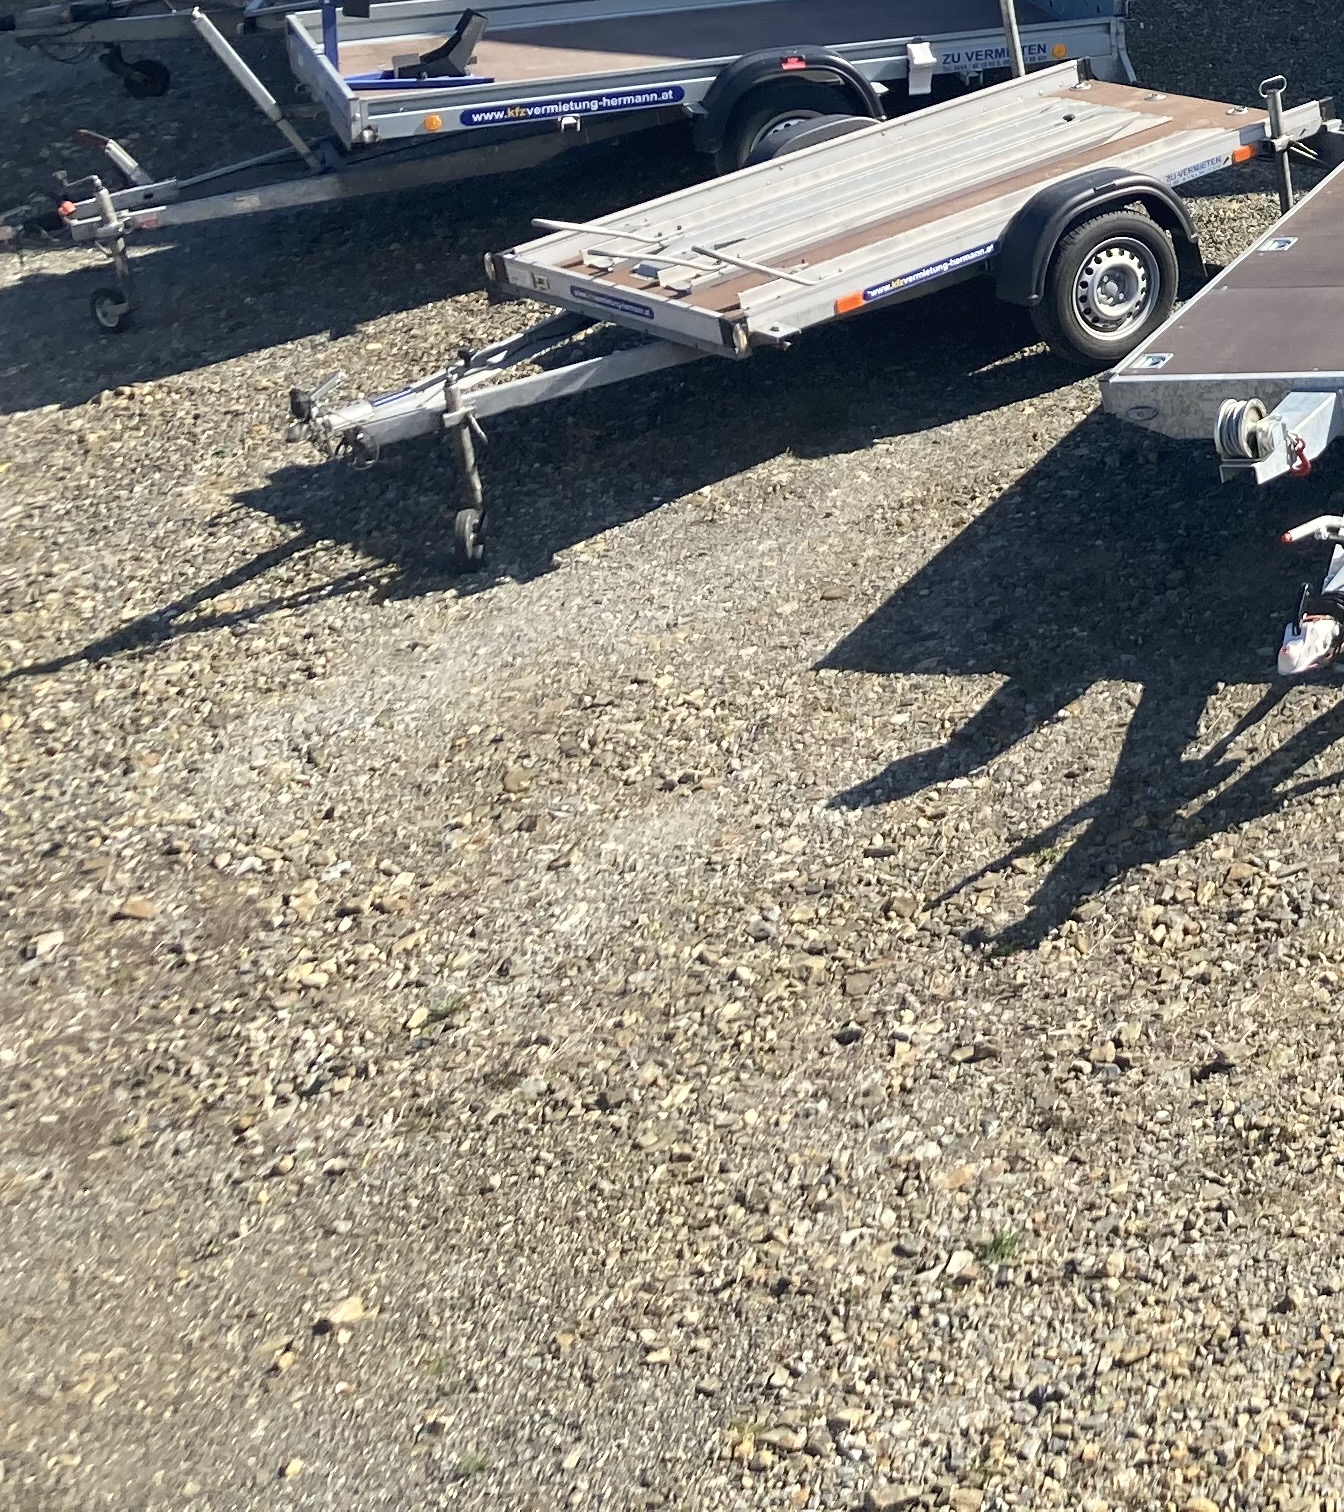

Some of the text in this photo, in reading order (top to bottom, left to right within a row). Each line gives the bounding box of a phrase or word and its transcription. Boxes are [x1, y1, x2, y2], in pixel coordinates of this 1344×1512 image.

[942, 53, 960, 64] ZU
[965, 43, 1047, 62] VERMITEN
[471, 88, 674, 122] www.kfzvermietung-hermann.at
